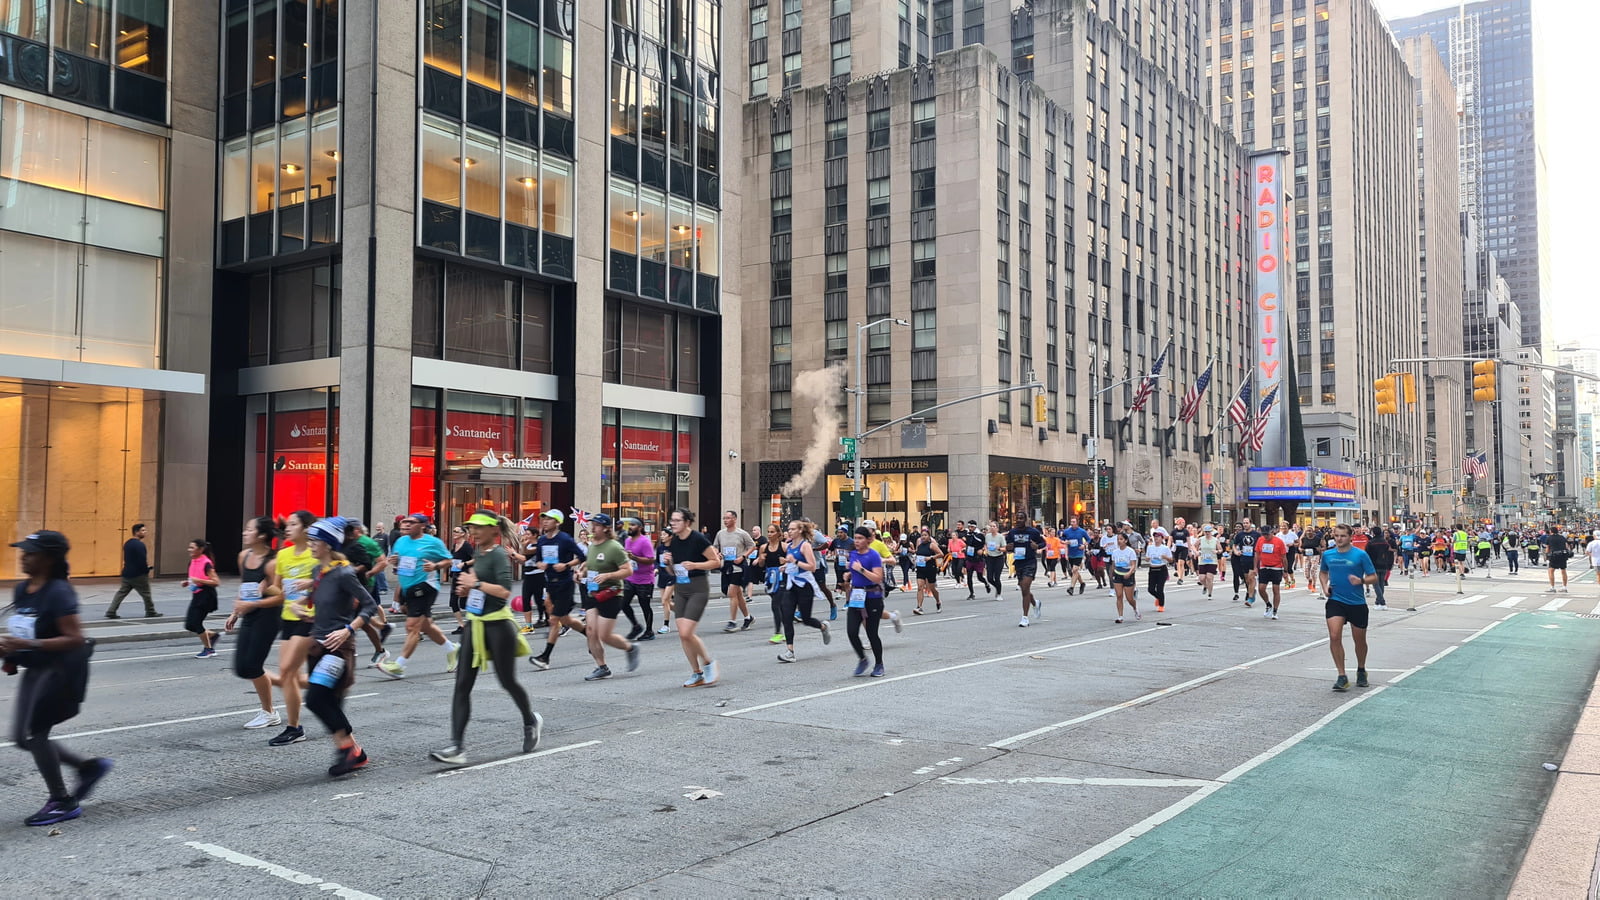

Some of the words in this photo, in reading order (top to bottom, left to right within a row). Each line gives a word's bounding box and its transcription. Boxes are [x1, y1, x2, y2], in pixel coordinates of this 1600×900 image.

[1258, 165, 1277, 273] RADIO
[1258, 292, 1279, 379] CITY
[453, 425, 501, 439] Santander
[624, 440, 660, 452] Santander
[502, 453, 564, 471] Santander
[879, 460, 929, 470] BROTHERS
